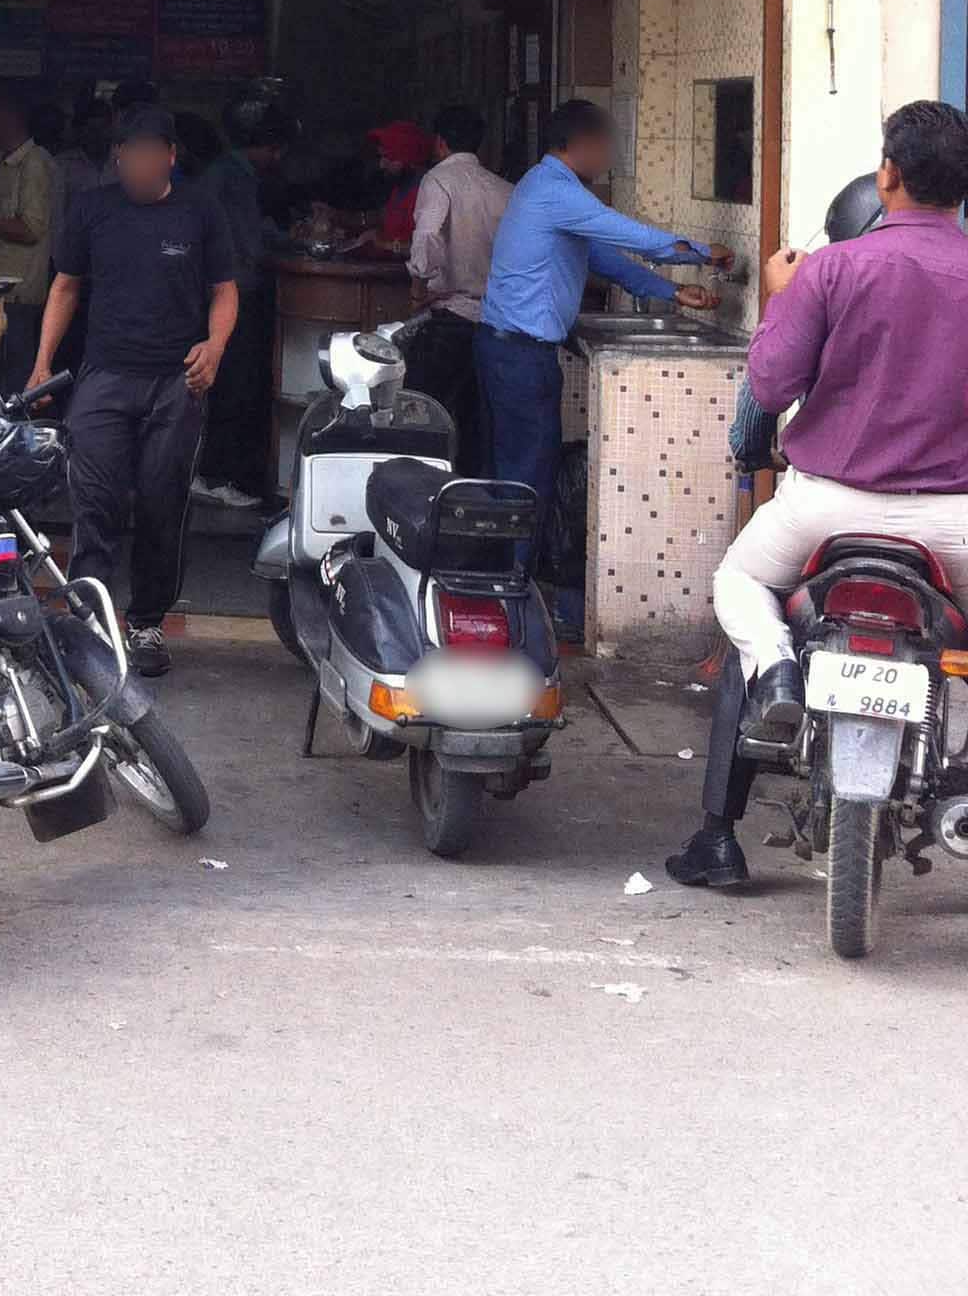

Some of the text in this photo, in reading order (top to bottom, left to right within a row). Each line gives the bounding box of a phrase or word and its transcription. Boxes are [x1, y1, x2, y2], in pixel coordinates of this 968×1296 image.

[840, 661, 899, 685] UP 20
[859, 695, 912, 717] 9884
